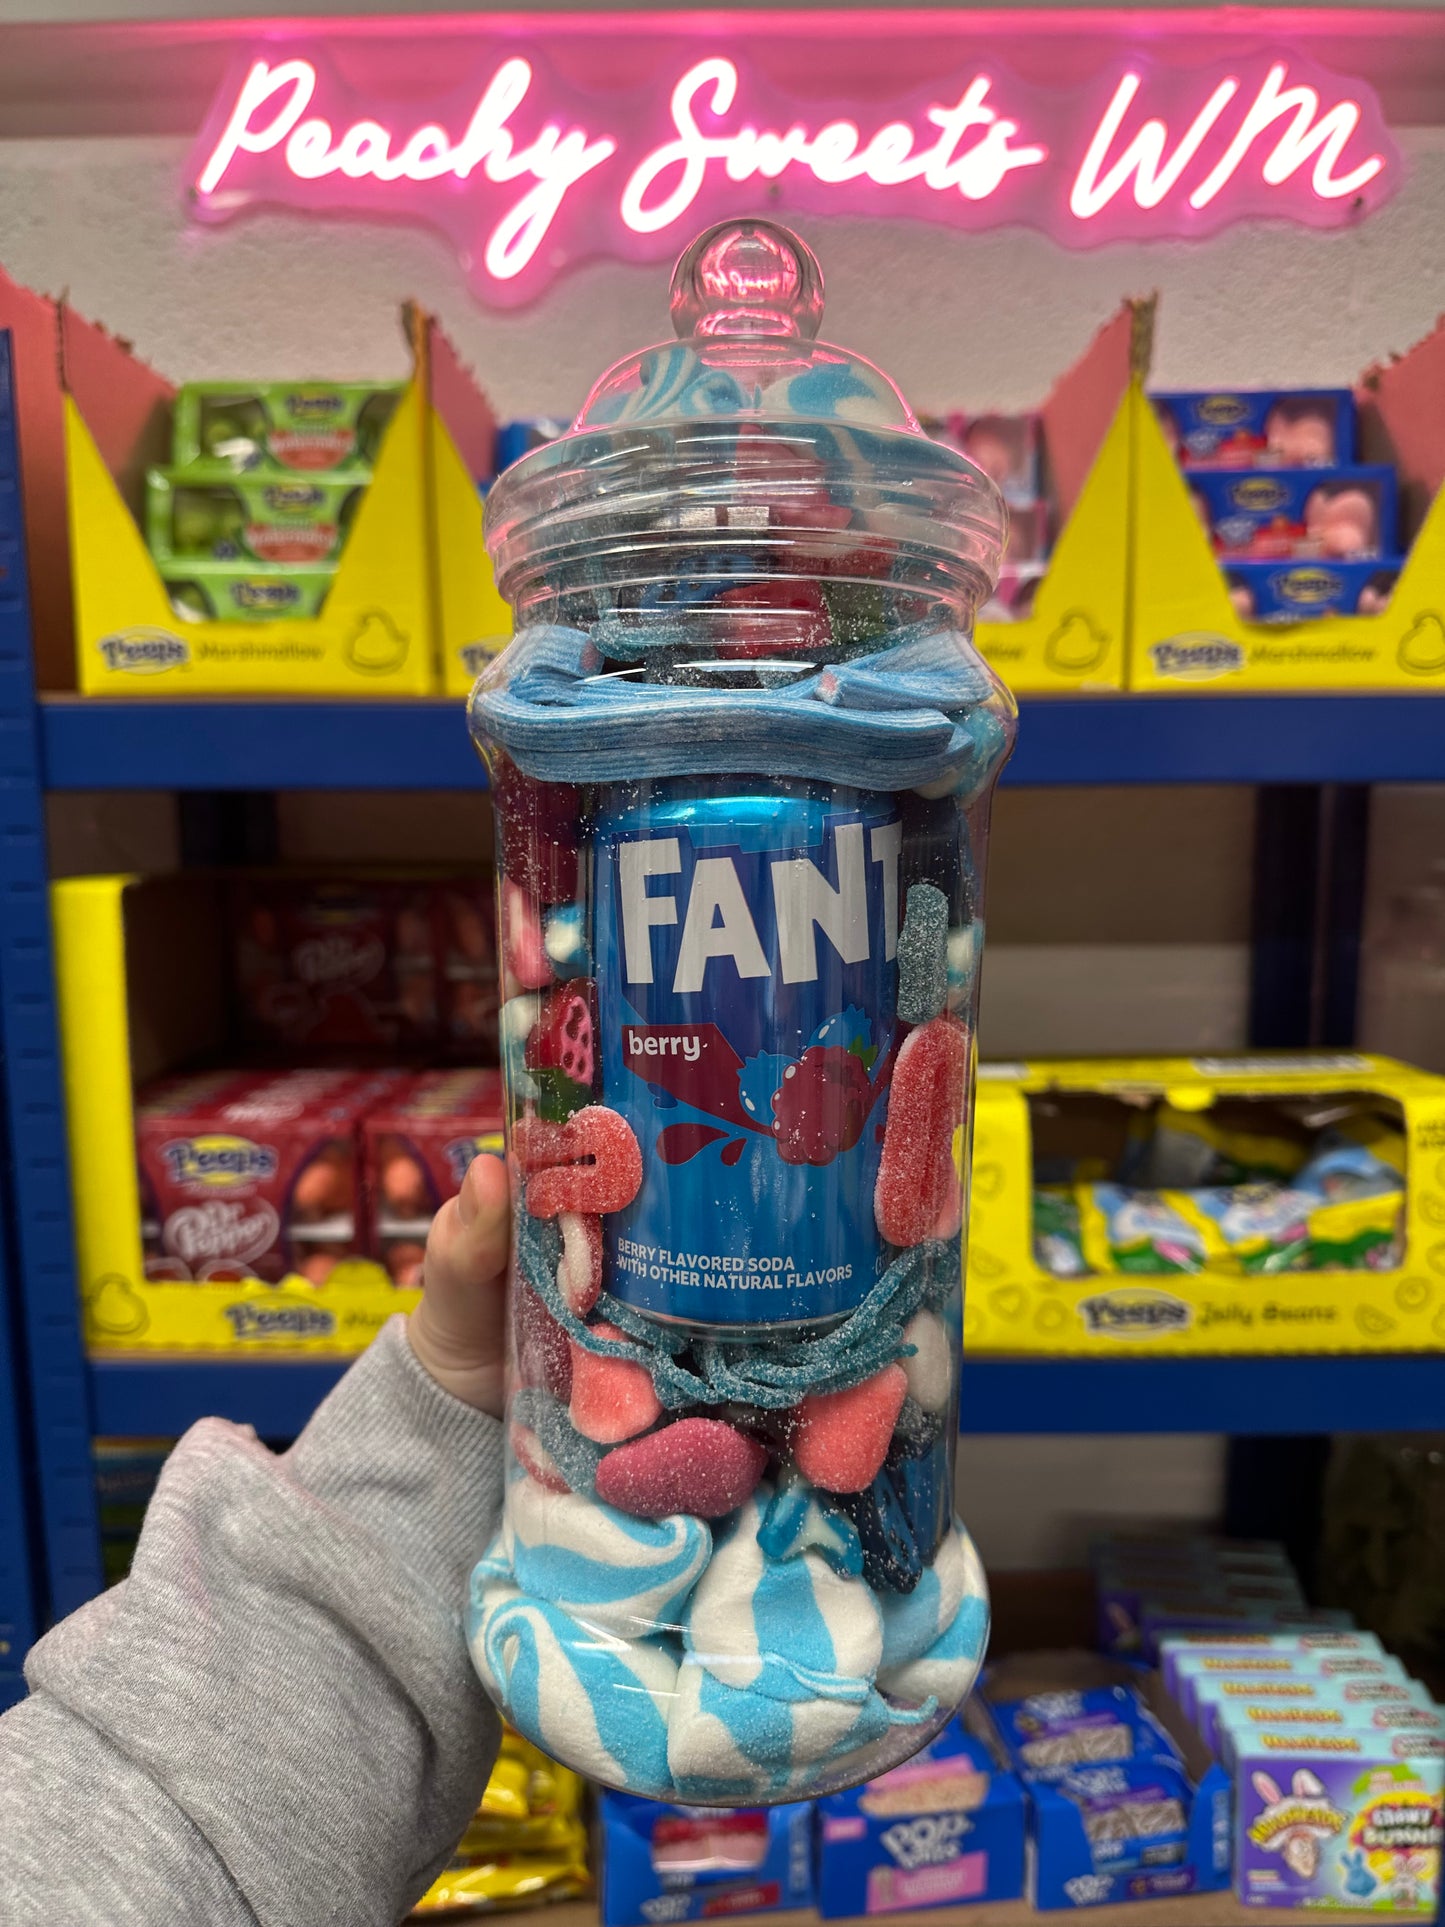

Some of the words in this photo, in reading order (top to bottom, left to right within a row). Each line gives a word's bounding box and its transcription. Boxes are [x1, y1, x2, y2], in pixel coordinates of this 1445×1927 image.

[194, 56, 616, 281] Peachy
[619, 56, 1047, 234] Sweets
[1068, 60, 1386, 219] WM
[628, 1029, 700, 1060] berry
[618, 1237, 656, 1261] BERRY
[658, 1245, 745, 1272] FLAVORED
[748, 1256, 795, 1273] SODA
[618, 1254, 648, 1277] WITH
[650, 1265, 700, 1287] OTHER
[703, 1273, 783, 1290] NATURAL
[786, 1263, 853, 1289] FLAVORS
